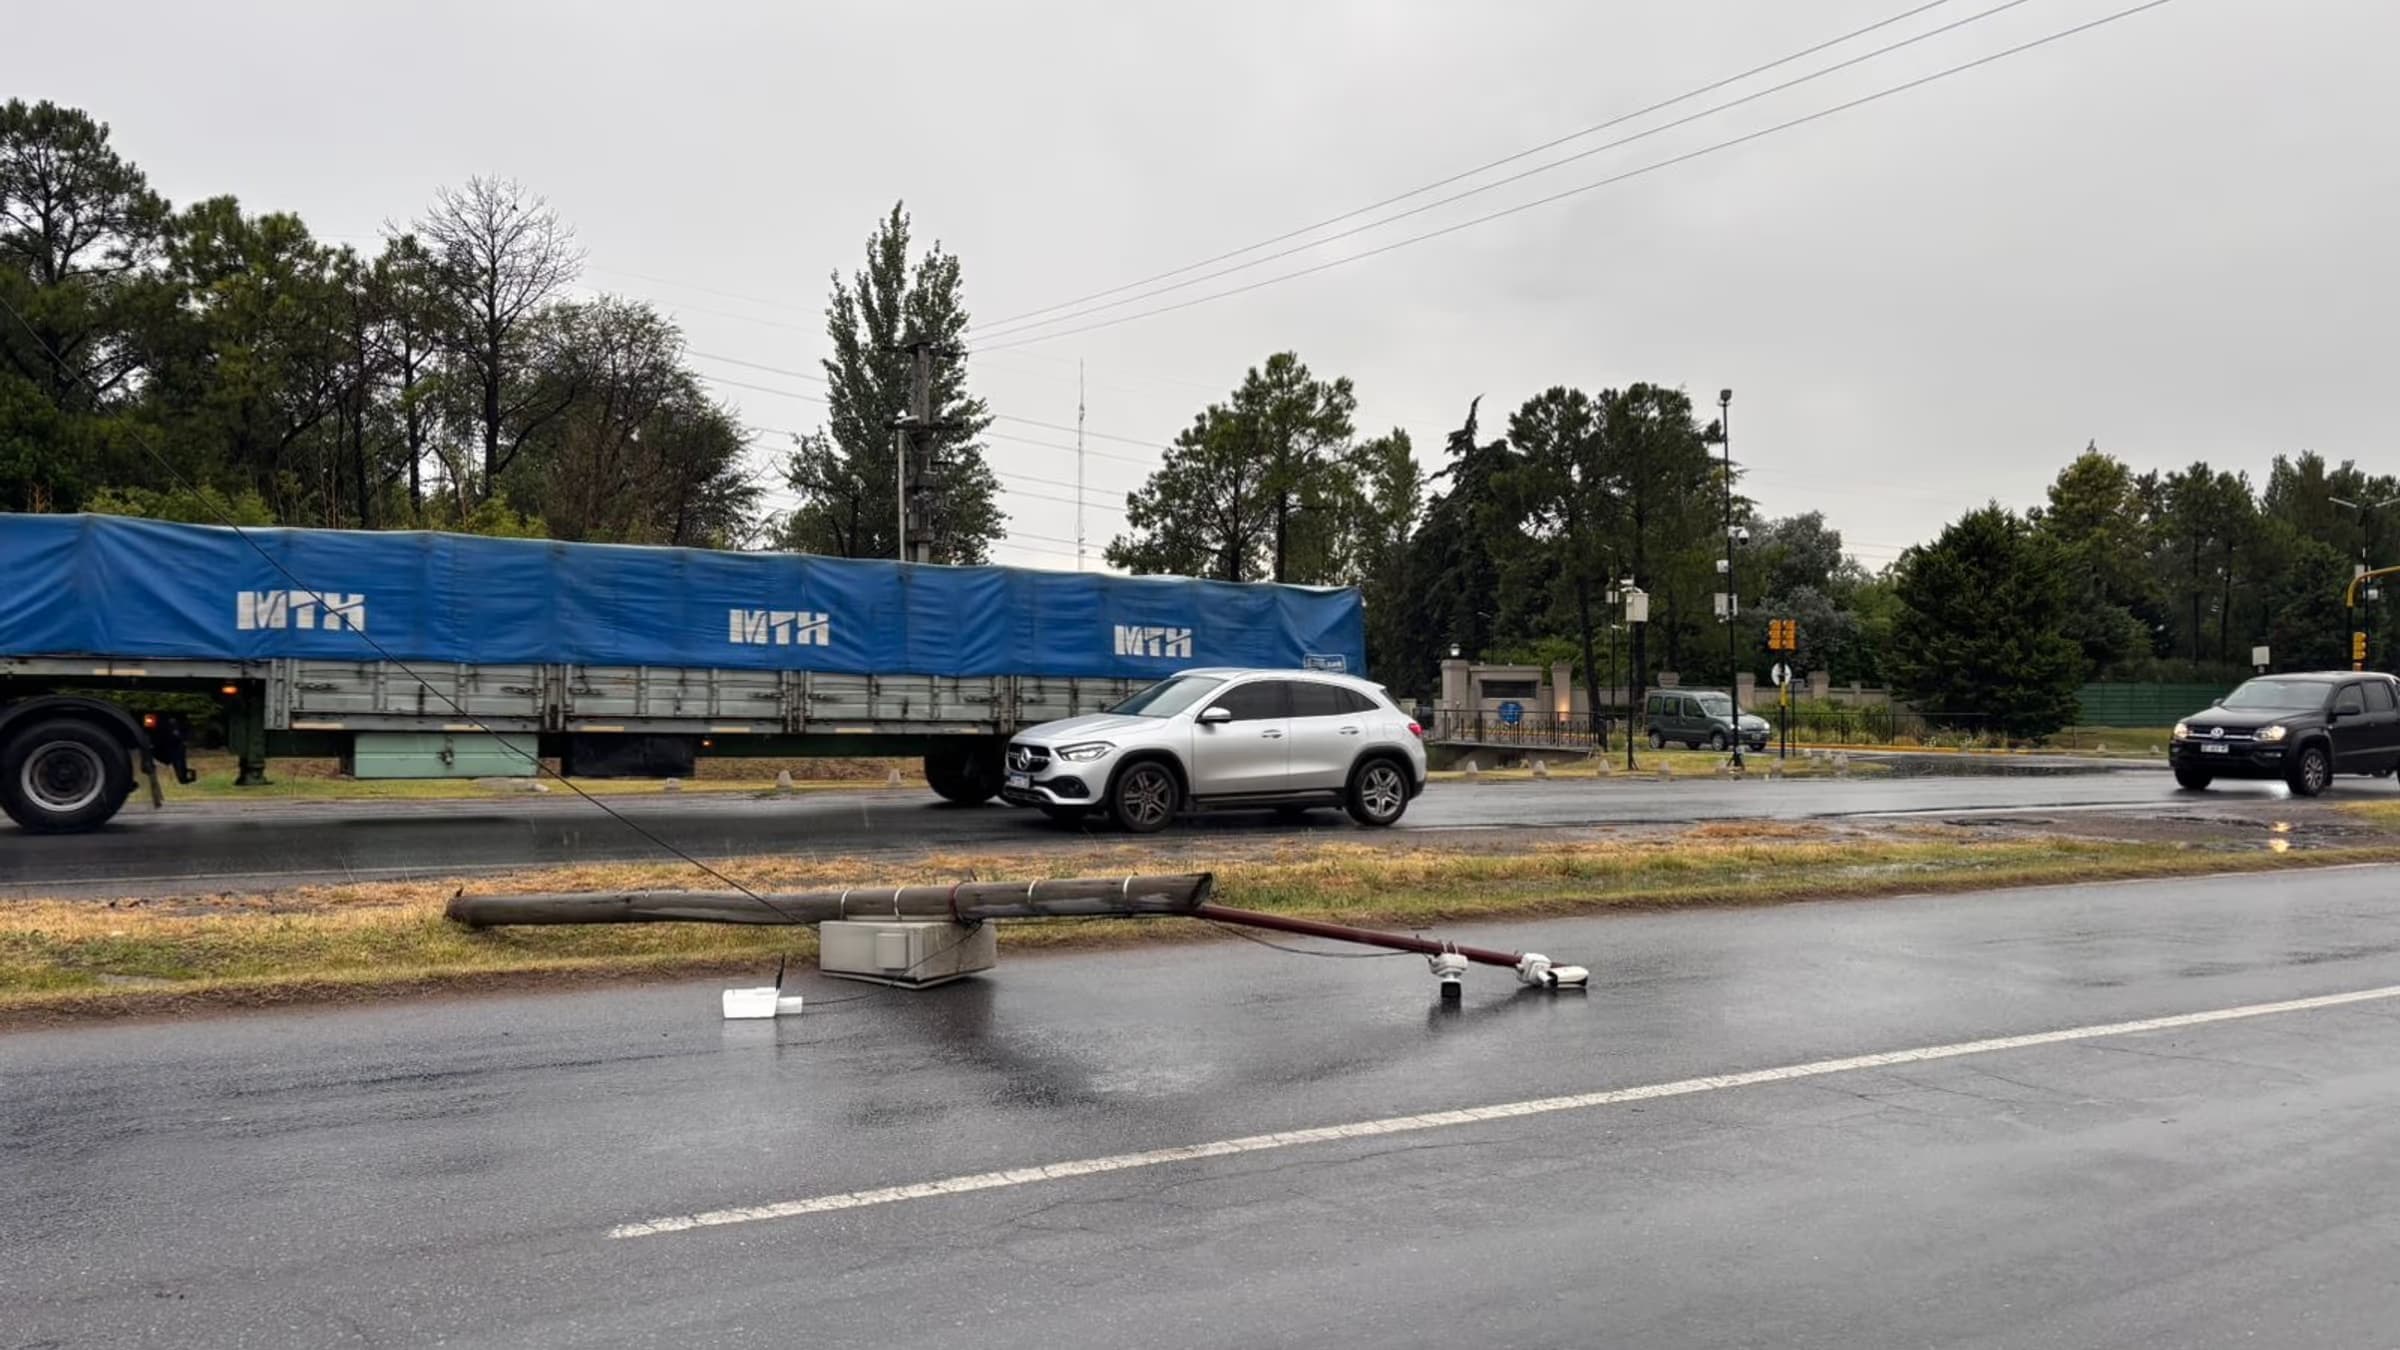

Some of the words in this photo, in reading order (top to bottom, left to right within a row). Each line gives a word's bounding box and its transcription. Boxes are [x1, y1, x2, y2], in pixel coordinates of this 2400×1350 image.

[236, 589, 365, 631] MTH
[729, 609, 829, 646] MTH
[1114, 624, 1192, 658] MTH
